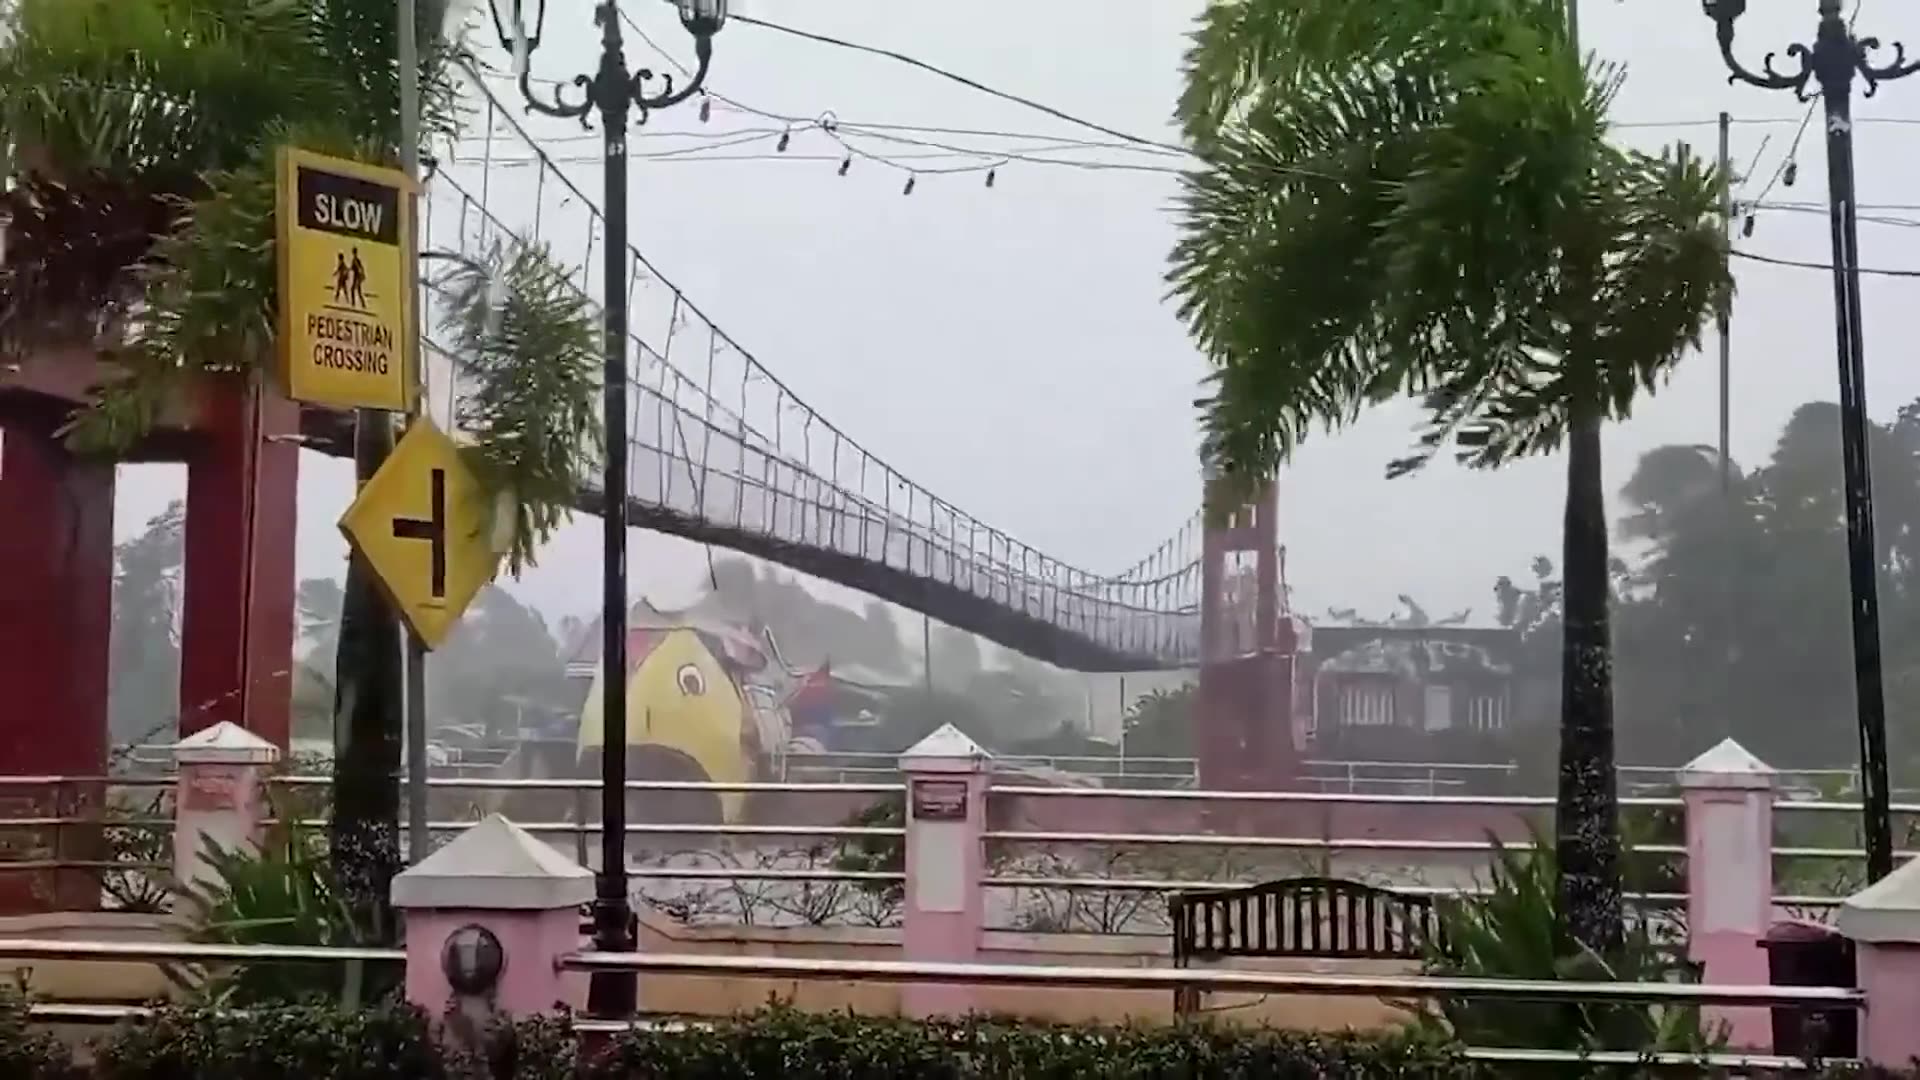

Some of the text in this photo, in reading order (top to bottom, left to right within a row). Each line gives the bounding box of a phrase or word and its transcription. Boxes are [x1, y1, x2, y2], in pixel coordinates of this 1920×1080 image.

[314, 193, 382, 234] SLOW
[307, 313, 392, 351] PEDESTRIAN
[313, 344, 388, 375] CROSSING
